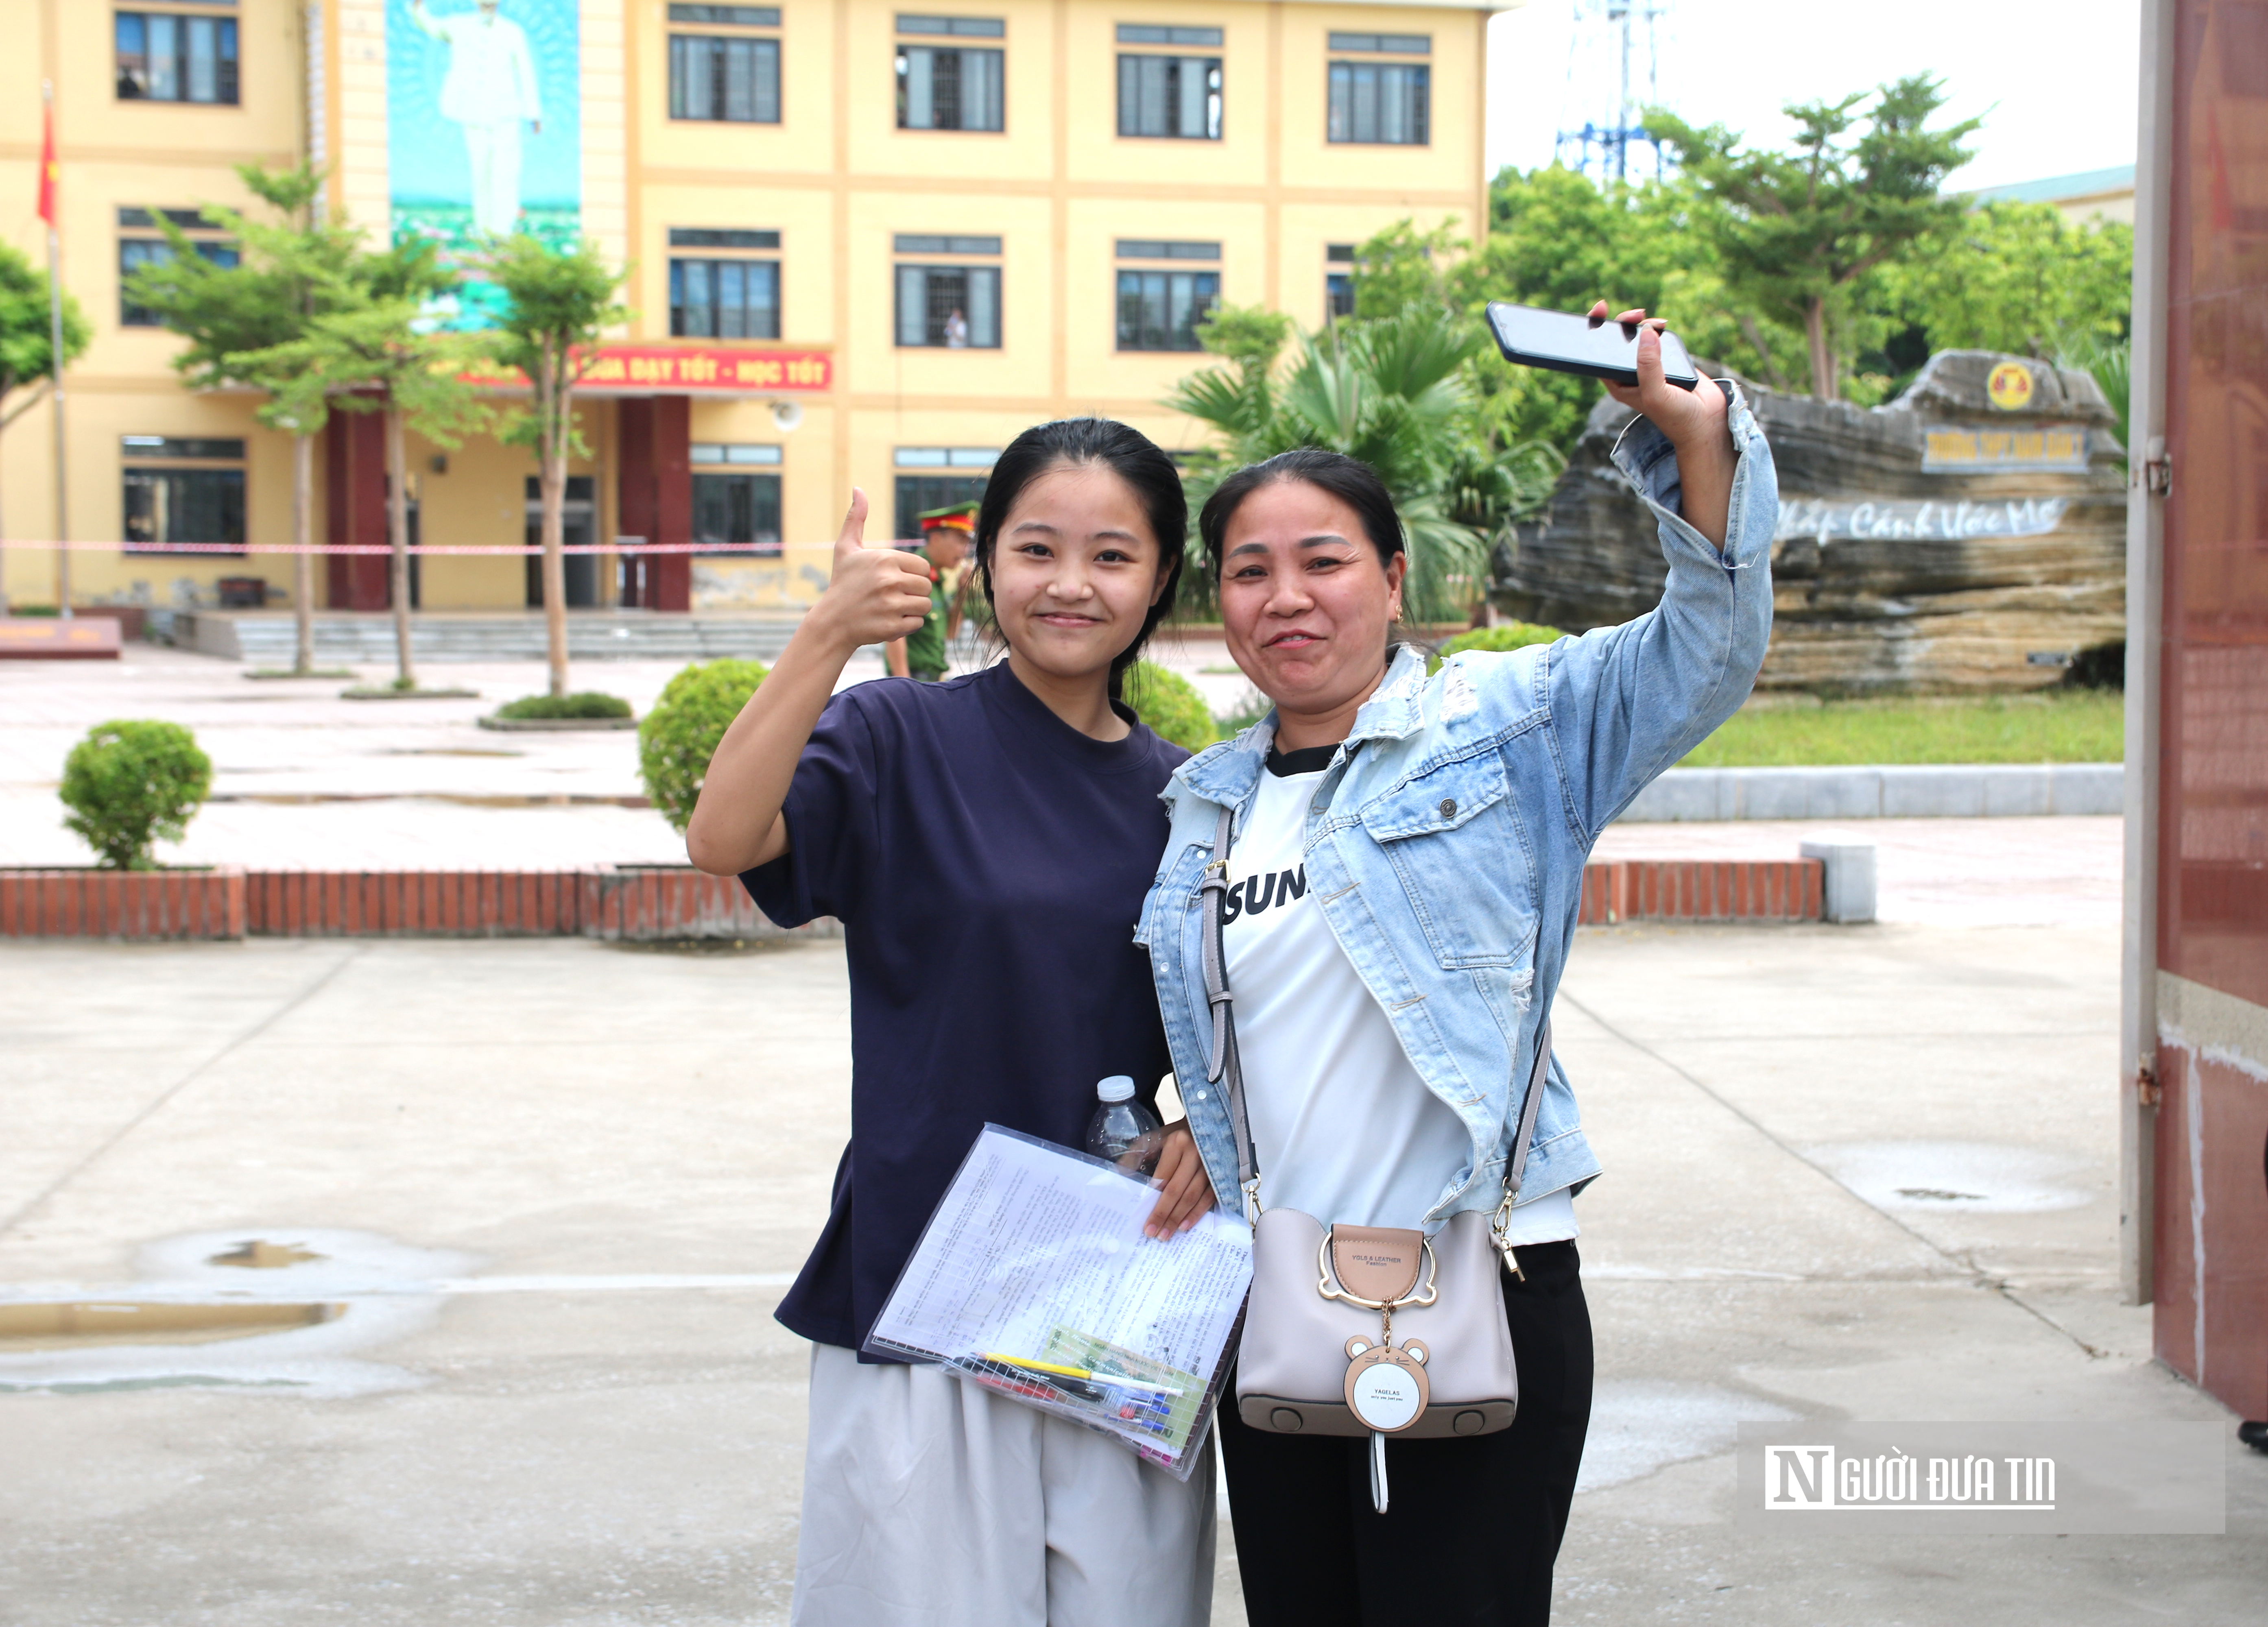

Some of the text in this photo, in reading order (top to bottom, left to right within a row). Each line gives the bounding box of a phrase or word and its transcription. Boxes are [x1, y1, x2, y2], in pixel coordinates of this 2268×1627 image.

[629, 357, 675, 385] DẠY
[678, 352, 718, 382] TỐT
[736, 359, 781, 386] HỌC
[786, 354, 826, 384] TỐT
[1849, 501, 1934, 539] Cánh
[2006, 497, 2068, 534] Mơ
